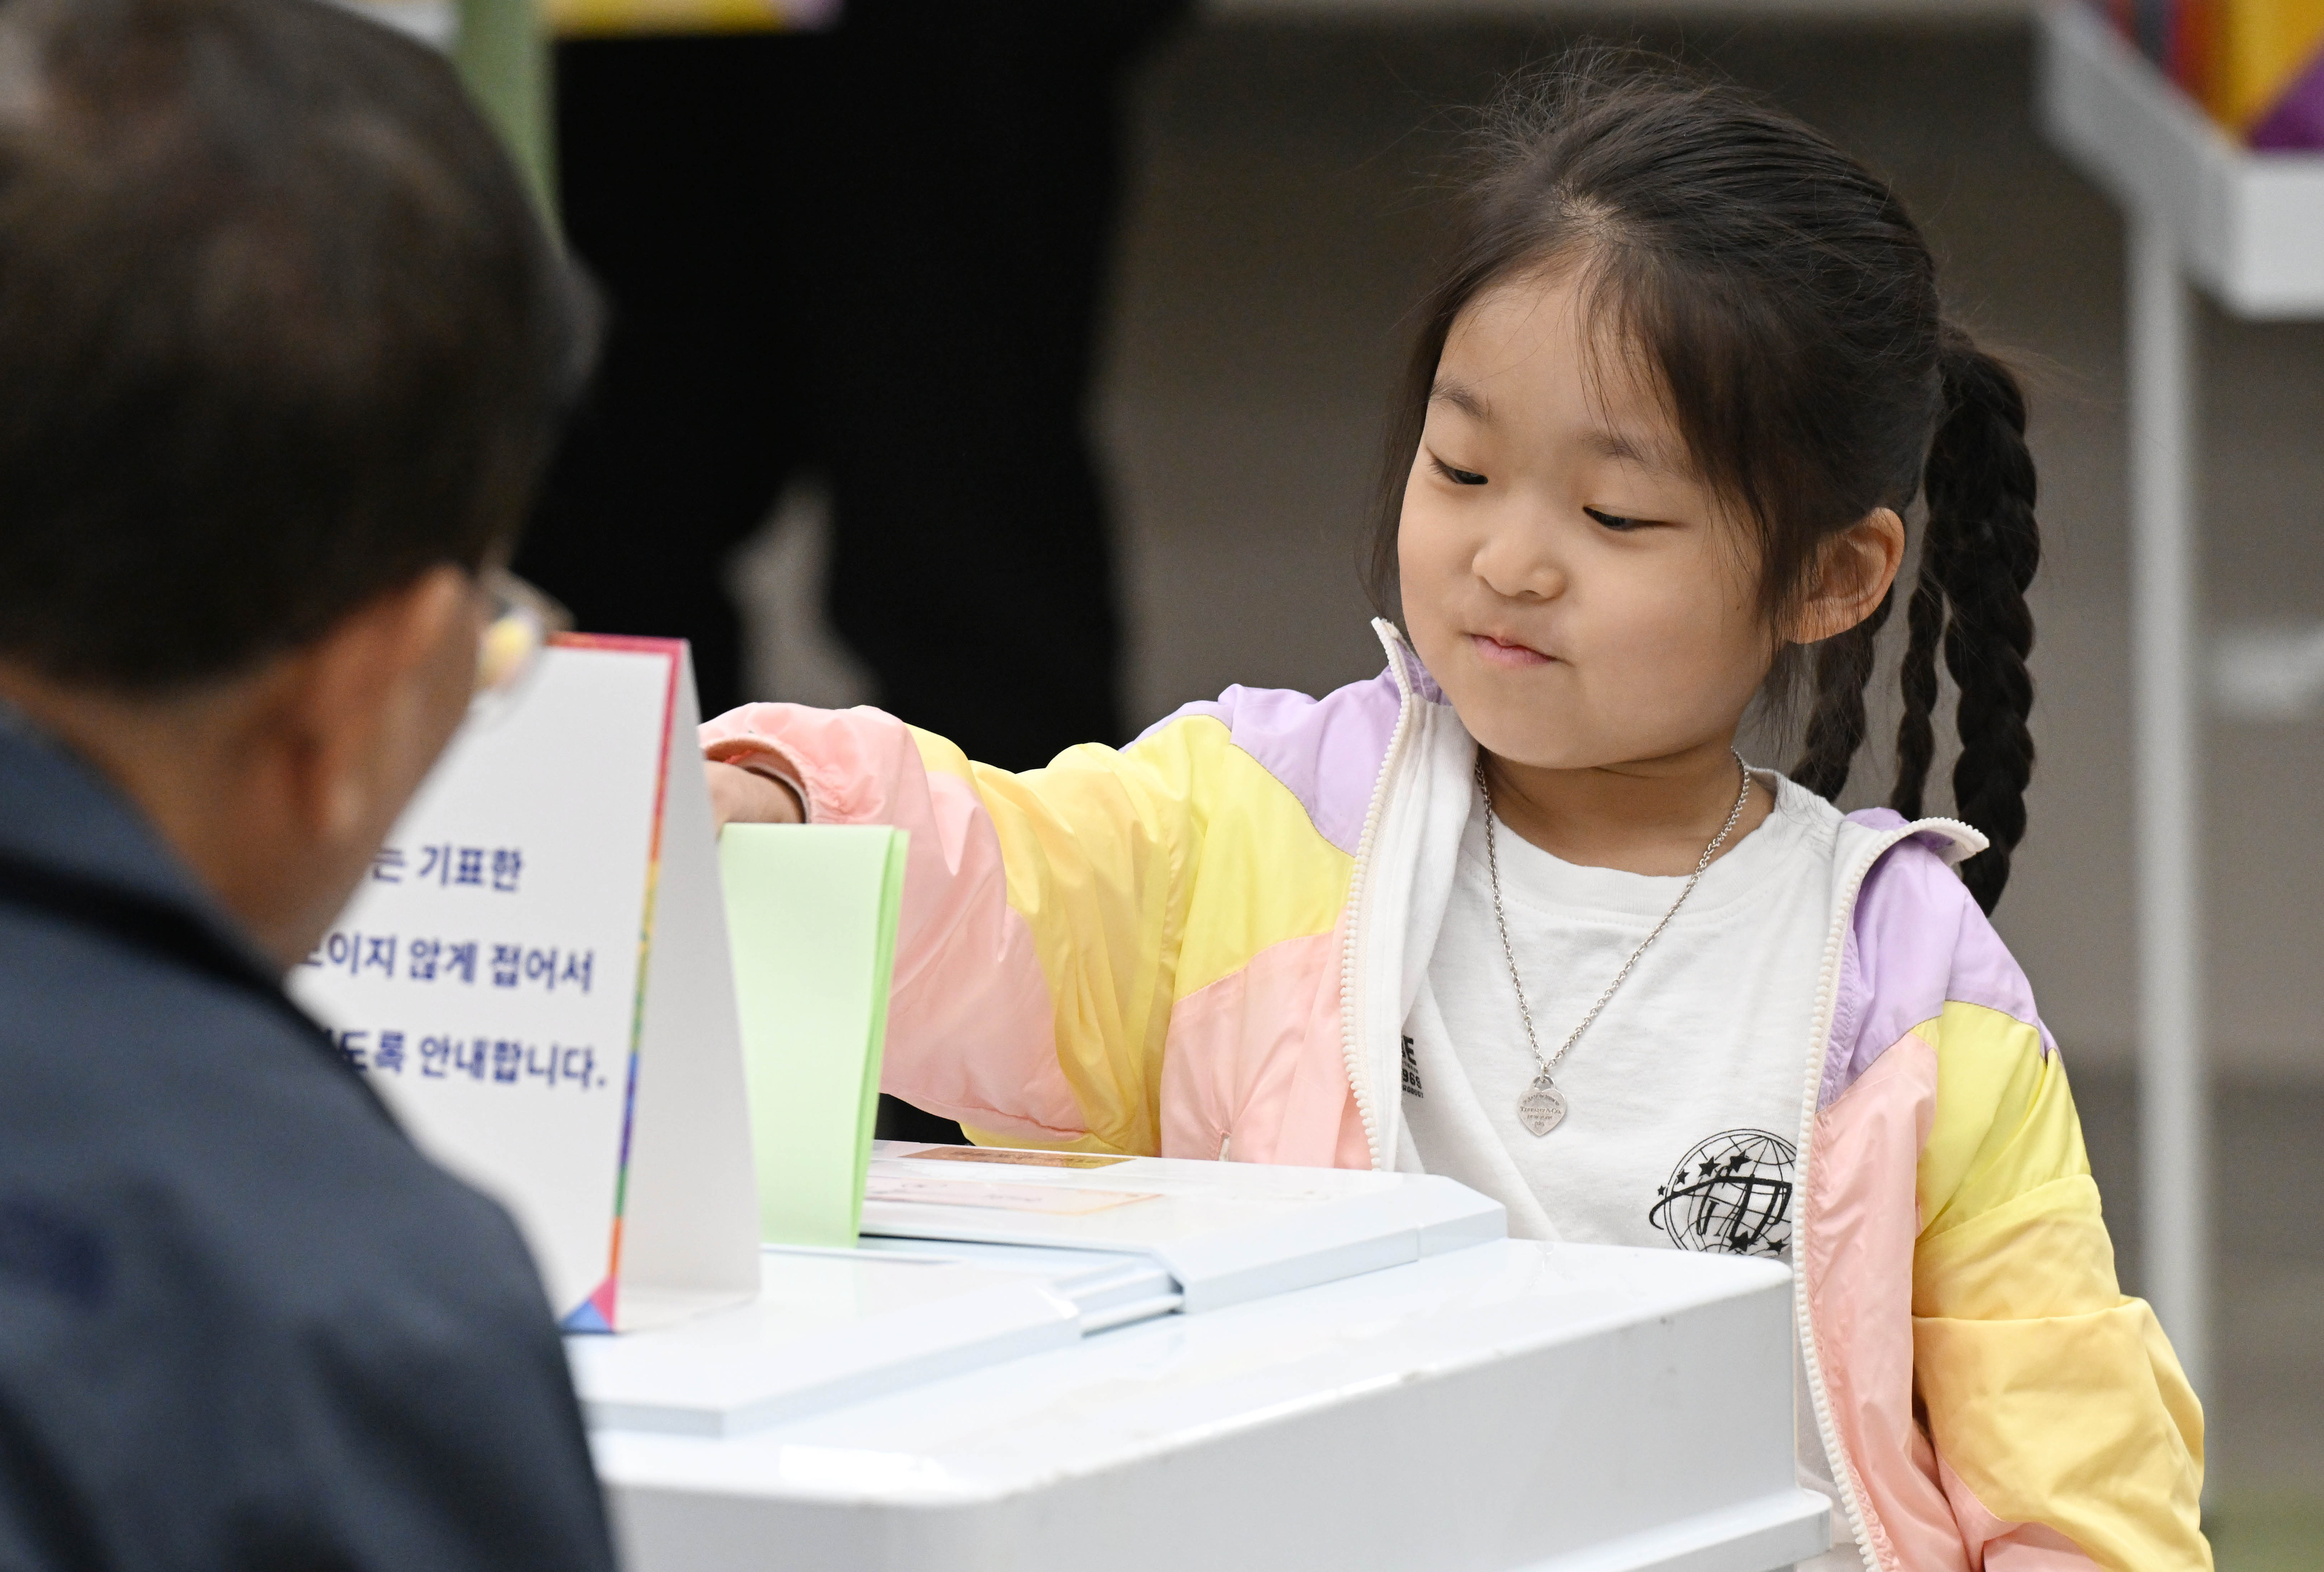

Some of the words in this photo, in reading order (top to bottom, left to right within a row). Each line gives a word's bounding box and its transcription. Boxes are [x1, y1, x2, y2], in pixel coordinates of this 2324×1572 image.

[371, 848, 406, 884] 는
[418, 843, 525, 892] 기표한
[409, 937, 478, 984] 않게
[491, 943, 594, 993] 접어서
[325, 1027, 406, 1074] 도록
[419, 1035, 607, 1090] 안내합니다.
[1401, 1085, 1423, 1099] RODUCT
